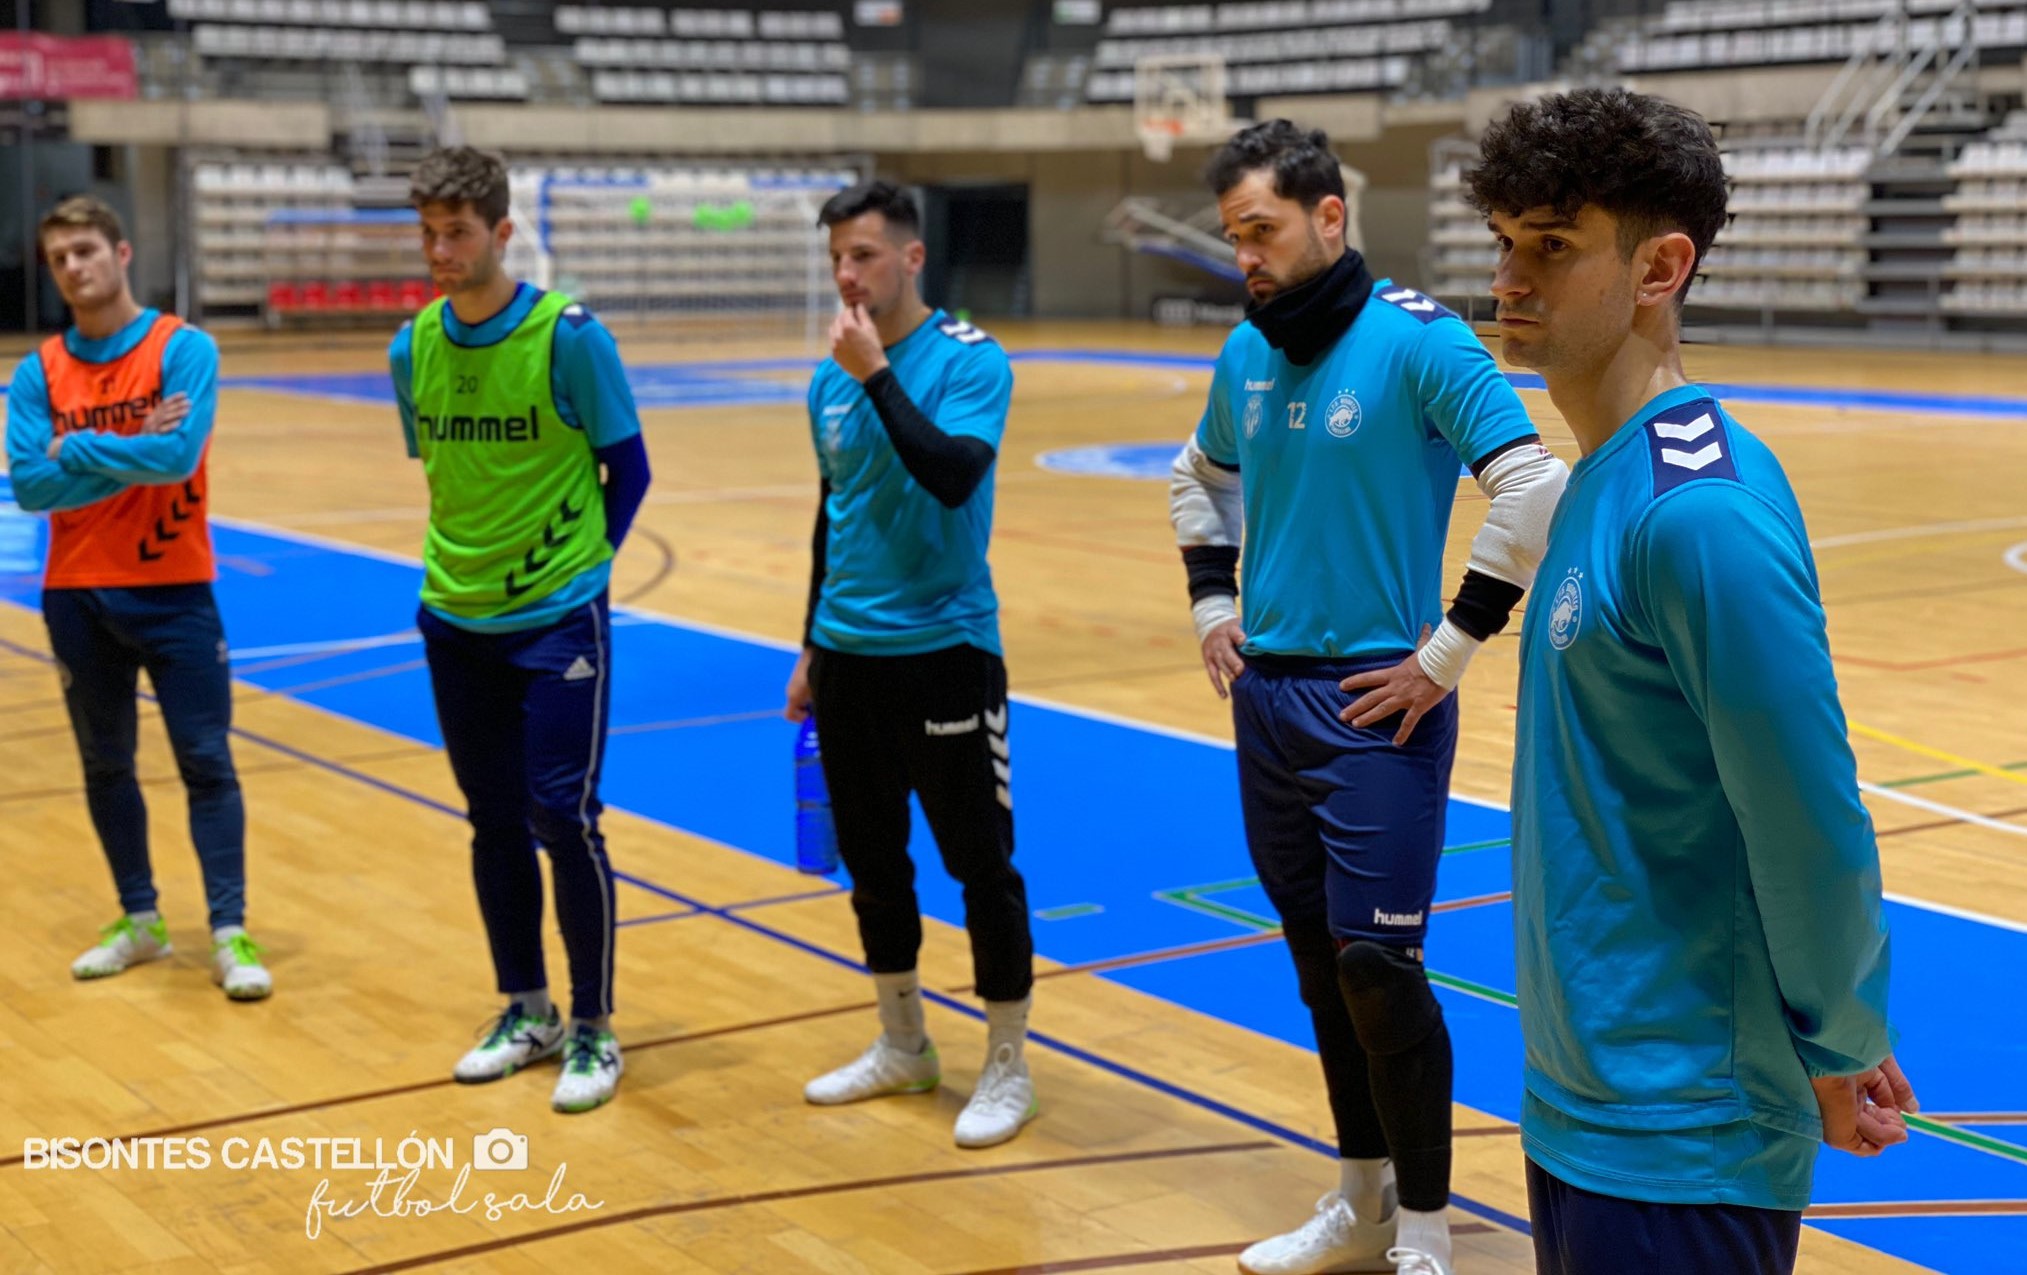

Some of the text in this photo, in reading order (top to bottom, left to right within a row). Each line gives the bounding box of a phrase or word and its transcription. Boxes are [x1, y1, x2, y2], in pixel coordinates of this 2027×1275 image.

[456, 374, 478, 395] 20
[1244, 377, 1275, 391] hummel
[415, 404, 539, 442] hummel
[1287, 401, 1307, 429] 12
[924, 713, 979, 736] hummel
[1373, 907, 1423, 926] hummel
